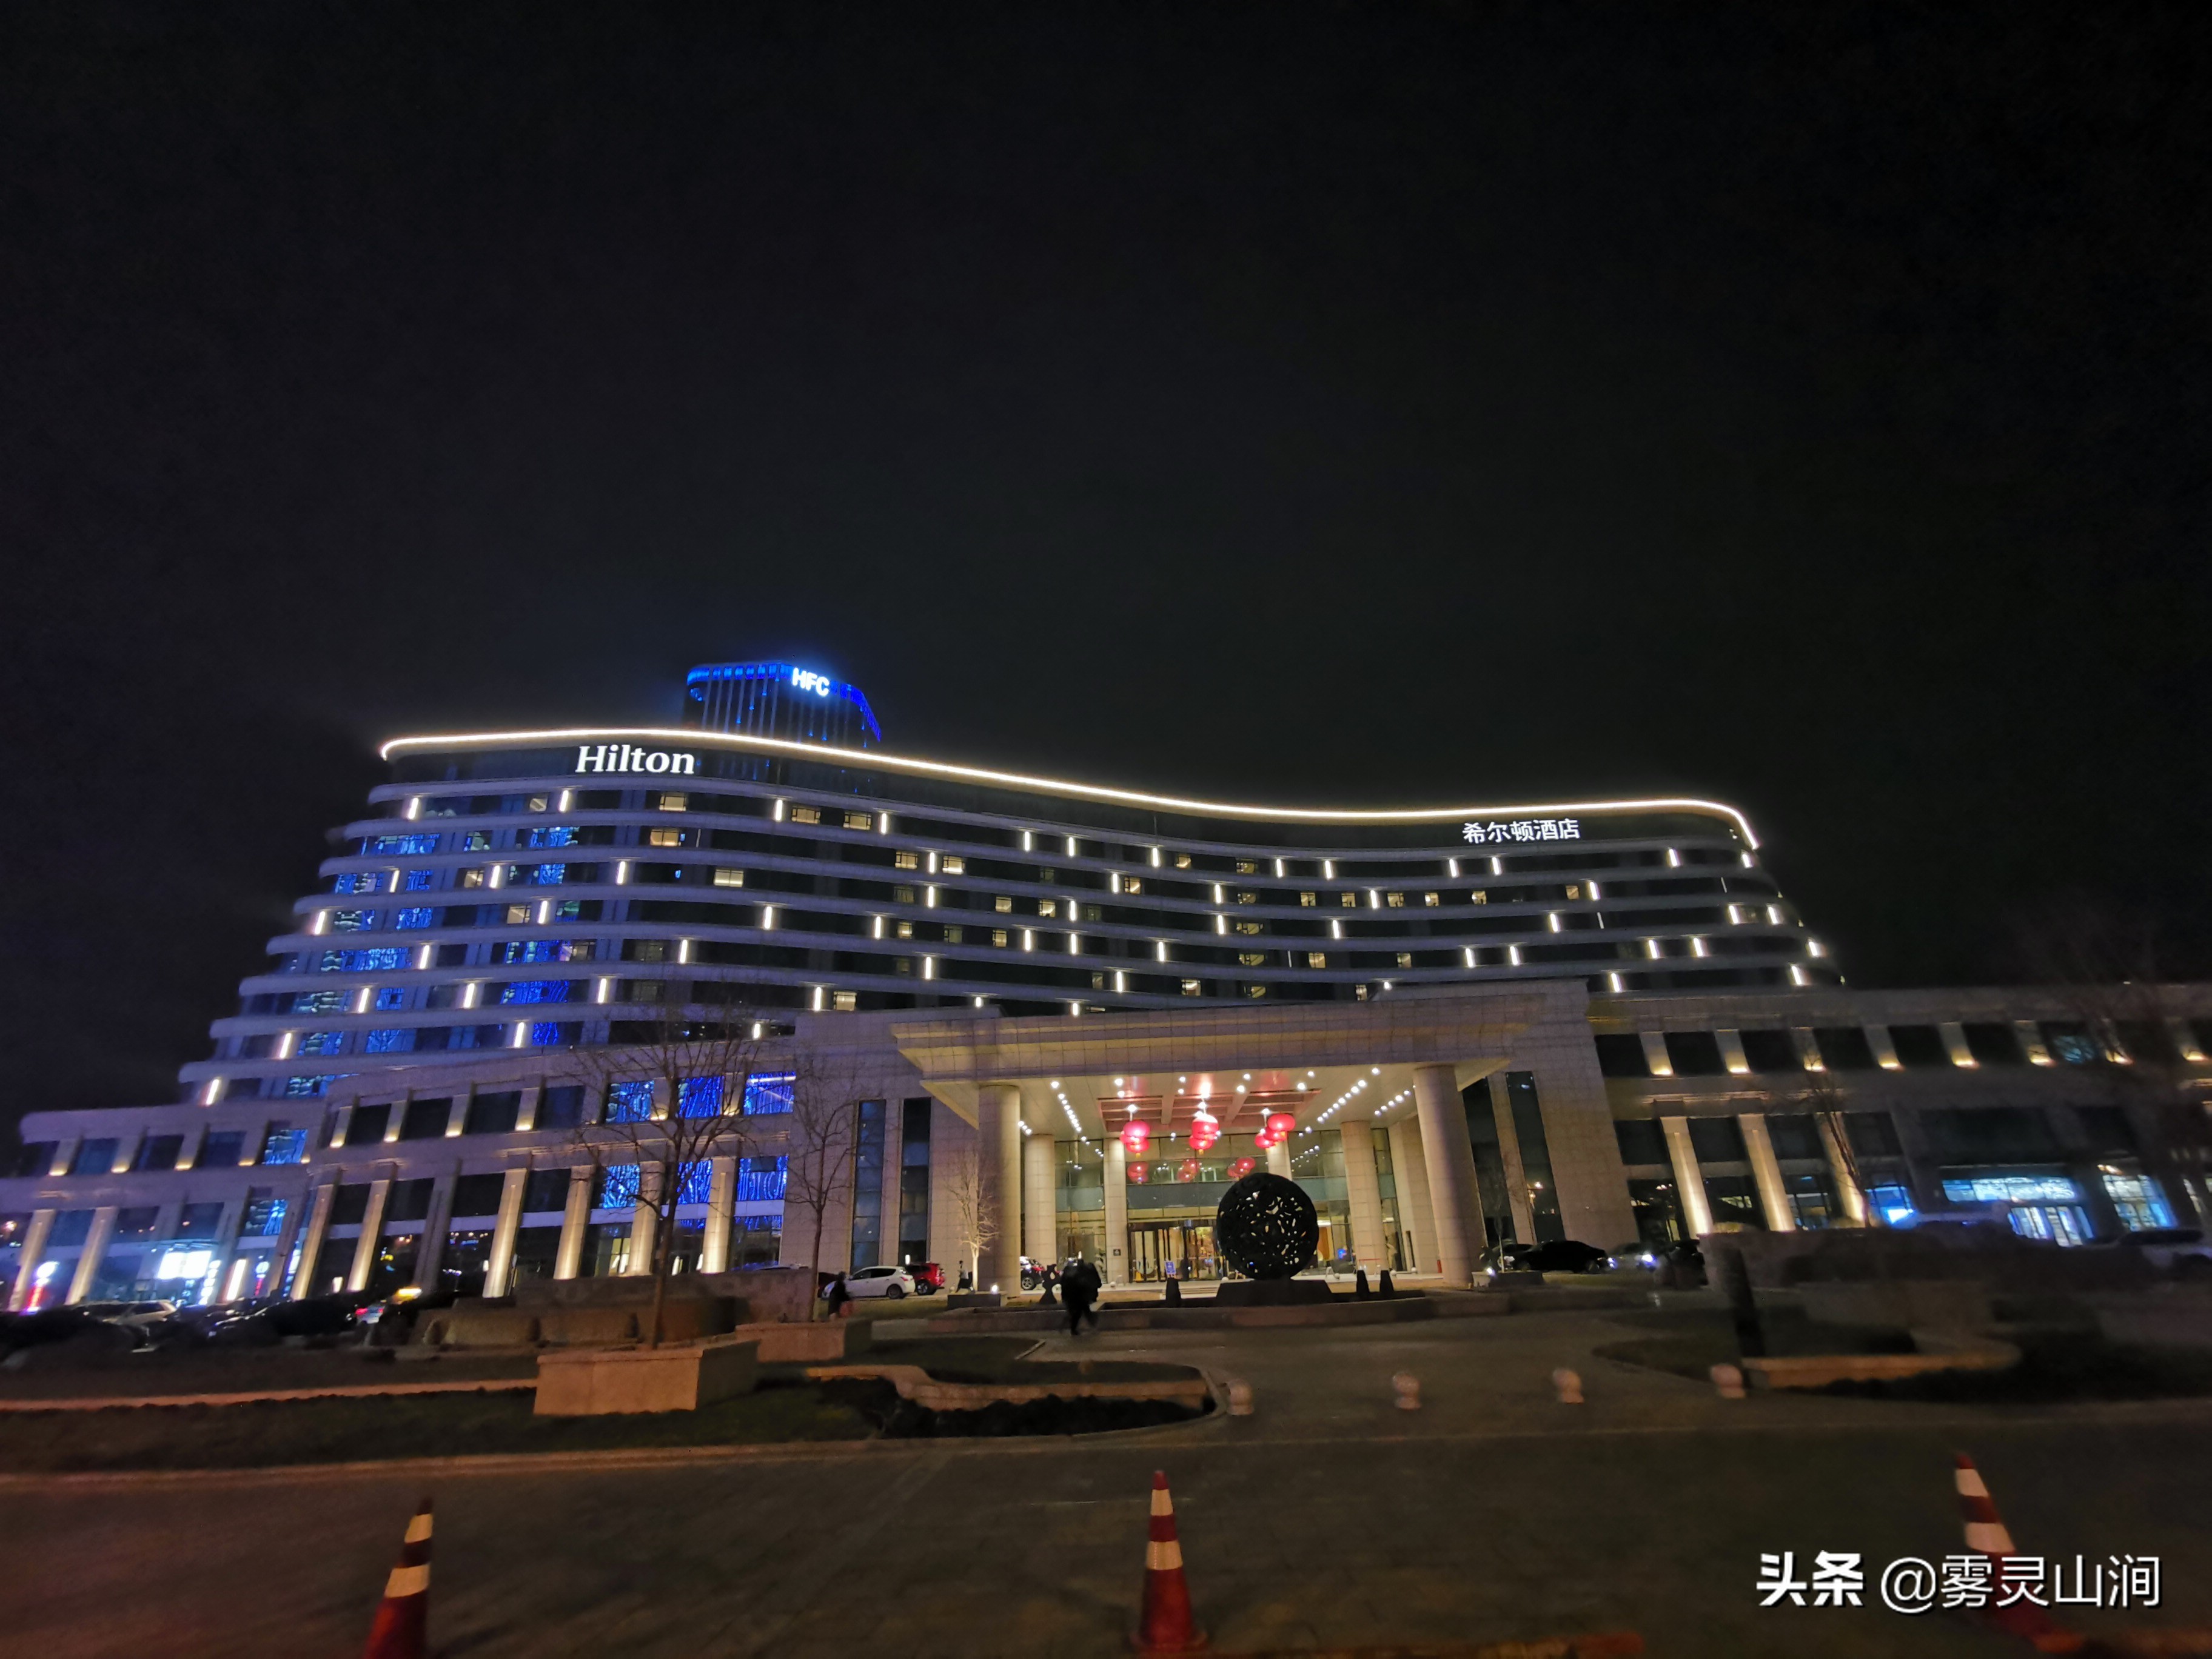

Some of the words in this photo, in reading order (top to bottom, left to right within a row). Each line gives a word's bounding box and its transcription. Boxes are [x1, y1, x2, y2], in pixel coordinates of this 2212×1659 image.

[792, 667, 830, 697] HFC
[575, 744, 695, 775] Hilton
[1462, 818, 1580, 844] 希尔顿酒店
